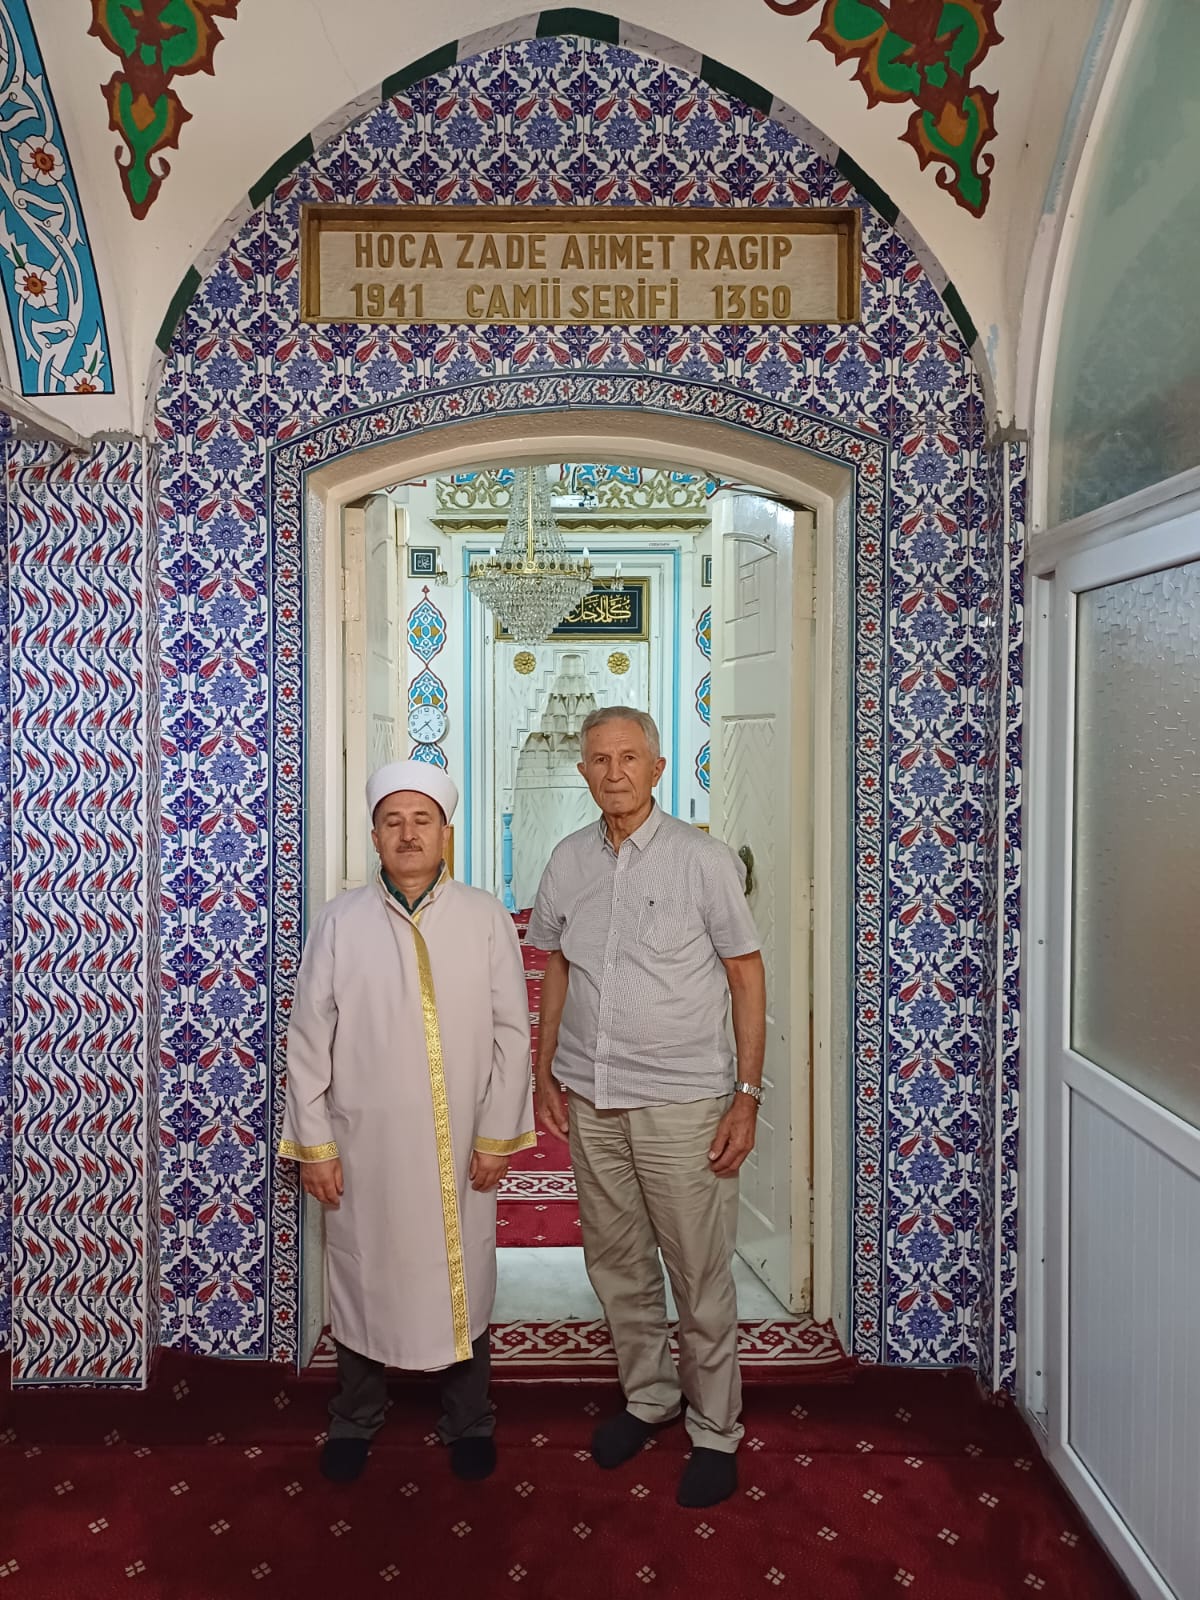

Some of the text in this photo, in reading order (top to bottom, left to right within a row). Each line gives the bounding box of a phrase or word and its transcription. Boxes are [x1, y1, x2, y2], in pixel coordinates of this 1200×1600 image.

[355, 233, 793, 270] HOCA ZADE AHMET RAGIP
[350, 283, 423, 317] 1941
[711, 284, 792, 319] 1360
